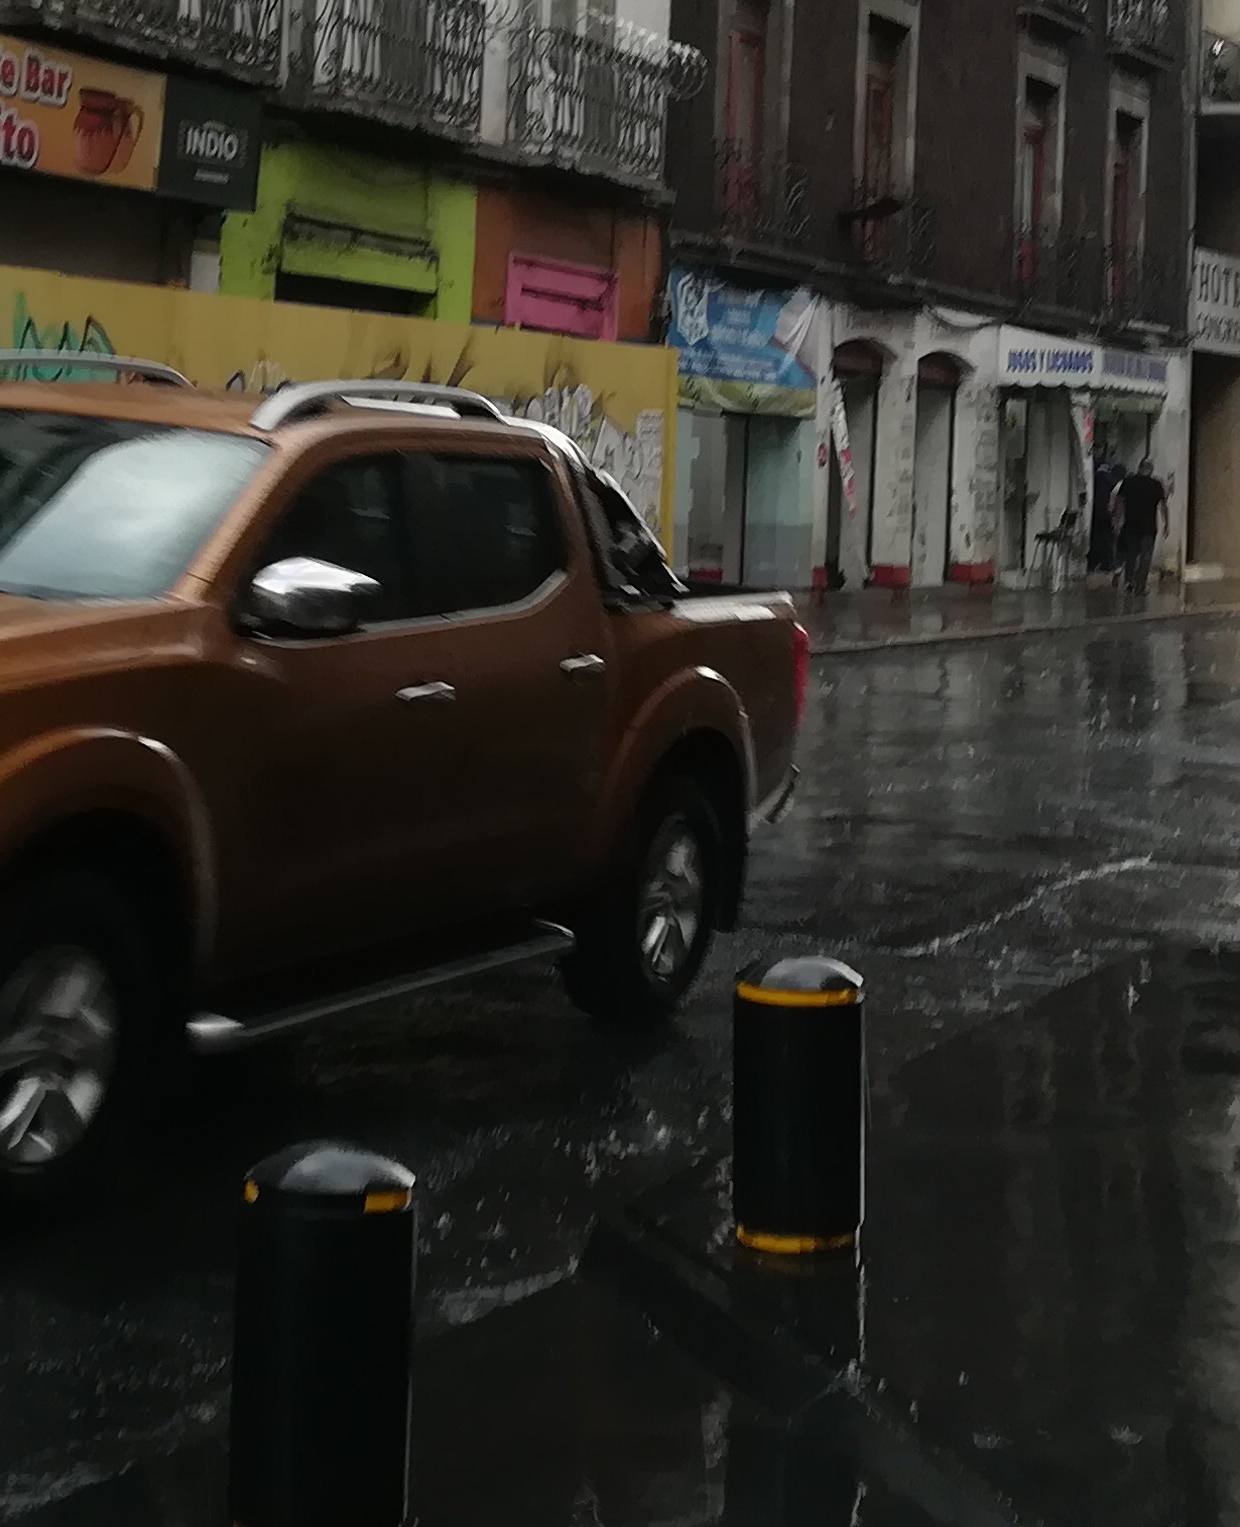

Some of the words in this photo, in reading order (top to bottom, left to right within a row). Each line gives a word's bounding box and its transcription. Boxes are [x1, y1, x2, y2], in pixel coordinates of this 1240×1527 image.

[0, 53, 19, 94] e
[22, 49, 71, 105] Bar
[0, 108, 38, 168] to
[186, 126, 239, 161] INDIO
